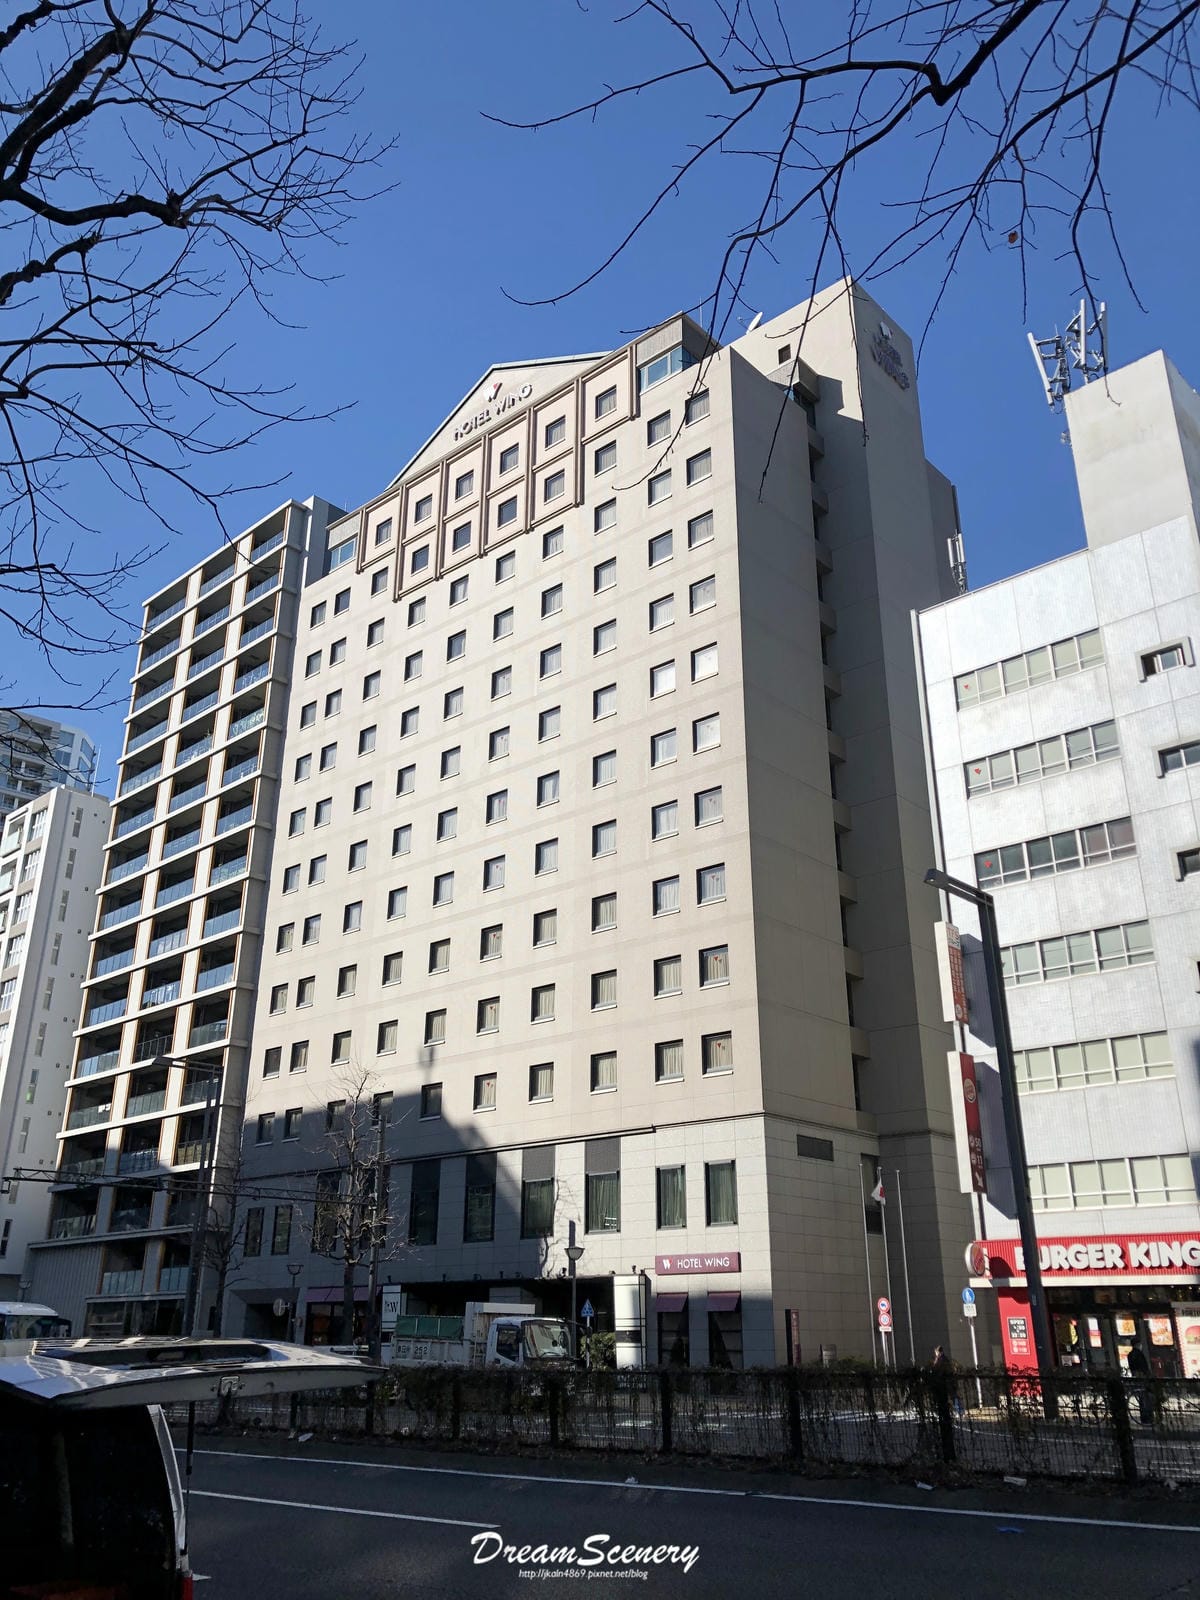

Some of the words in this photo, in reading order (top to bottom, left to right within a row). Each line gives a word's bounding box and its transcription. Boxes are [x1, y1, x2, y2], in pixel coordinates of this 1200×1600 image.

[453, 408, 492, 441] HOTEL
[494, 383, 533, 416] WING
[677, 1258, 702, 1269] HOTEL
[704, 1256, 730, 1267] WING
[1128, 1239, 1200, 1268] KING
